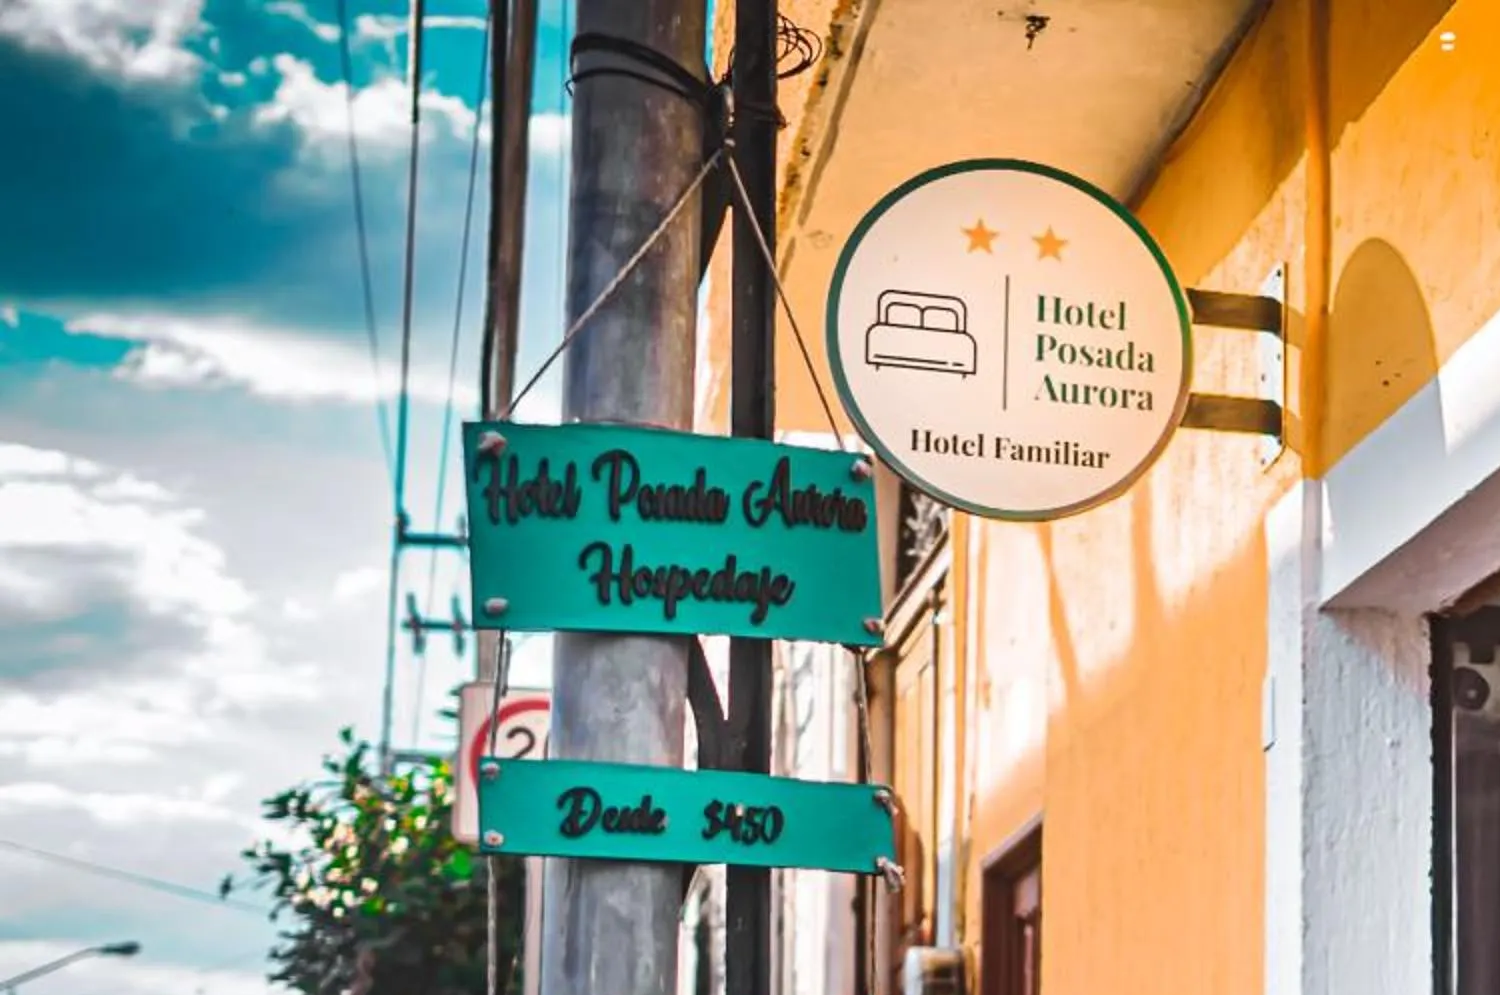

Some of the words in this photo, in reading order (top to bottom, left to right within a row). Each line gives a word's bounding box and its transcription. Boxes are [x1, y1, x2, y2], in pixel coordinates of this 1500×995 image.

[1035, 294, 1127, 331] Hotel
[1034, 333, 1156, 373] Posada
[1033, 373, 1155, 412] Aurora
[910, 428, 985, 458] Hotel
[994, 436, 1111, 469] Familiar
[472, 452, 582, 525] Hotel
[591, 448, 731, 525] Posada
[742, 455, 868, 532] Aurora
[578, 541, 796, 626] Hospedaje
[506, 726, 549, 760] 2
[557, 786, 667, 839] Desde
[701, 799, 785, 845] $450
